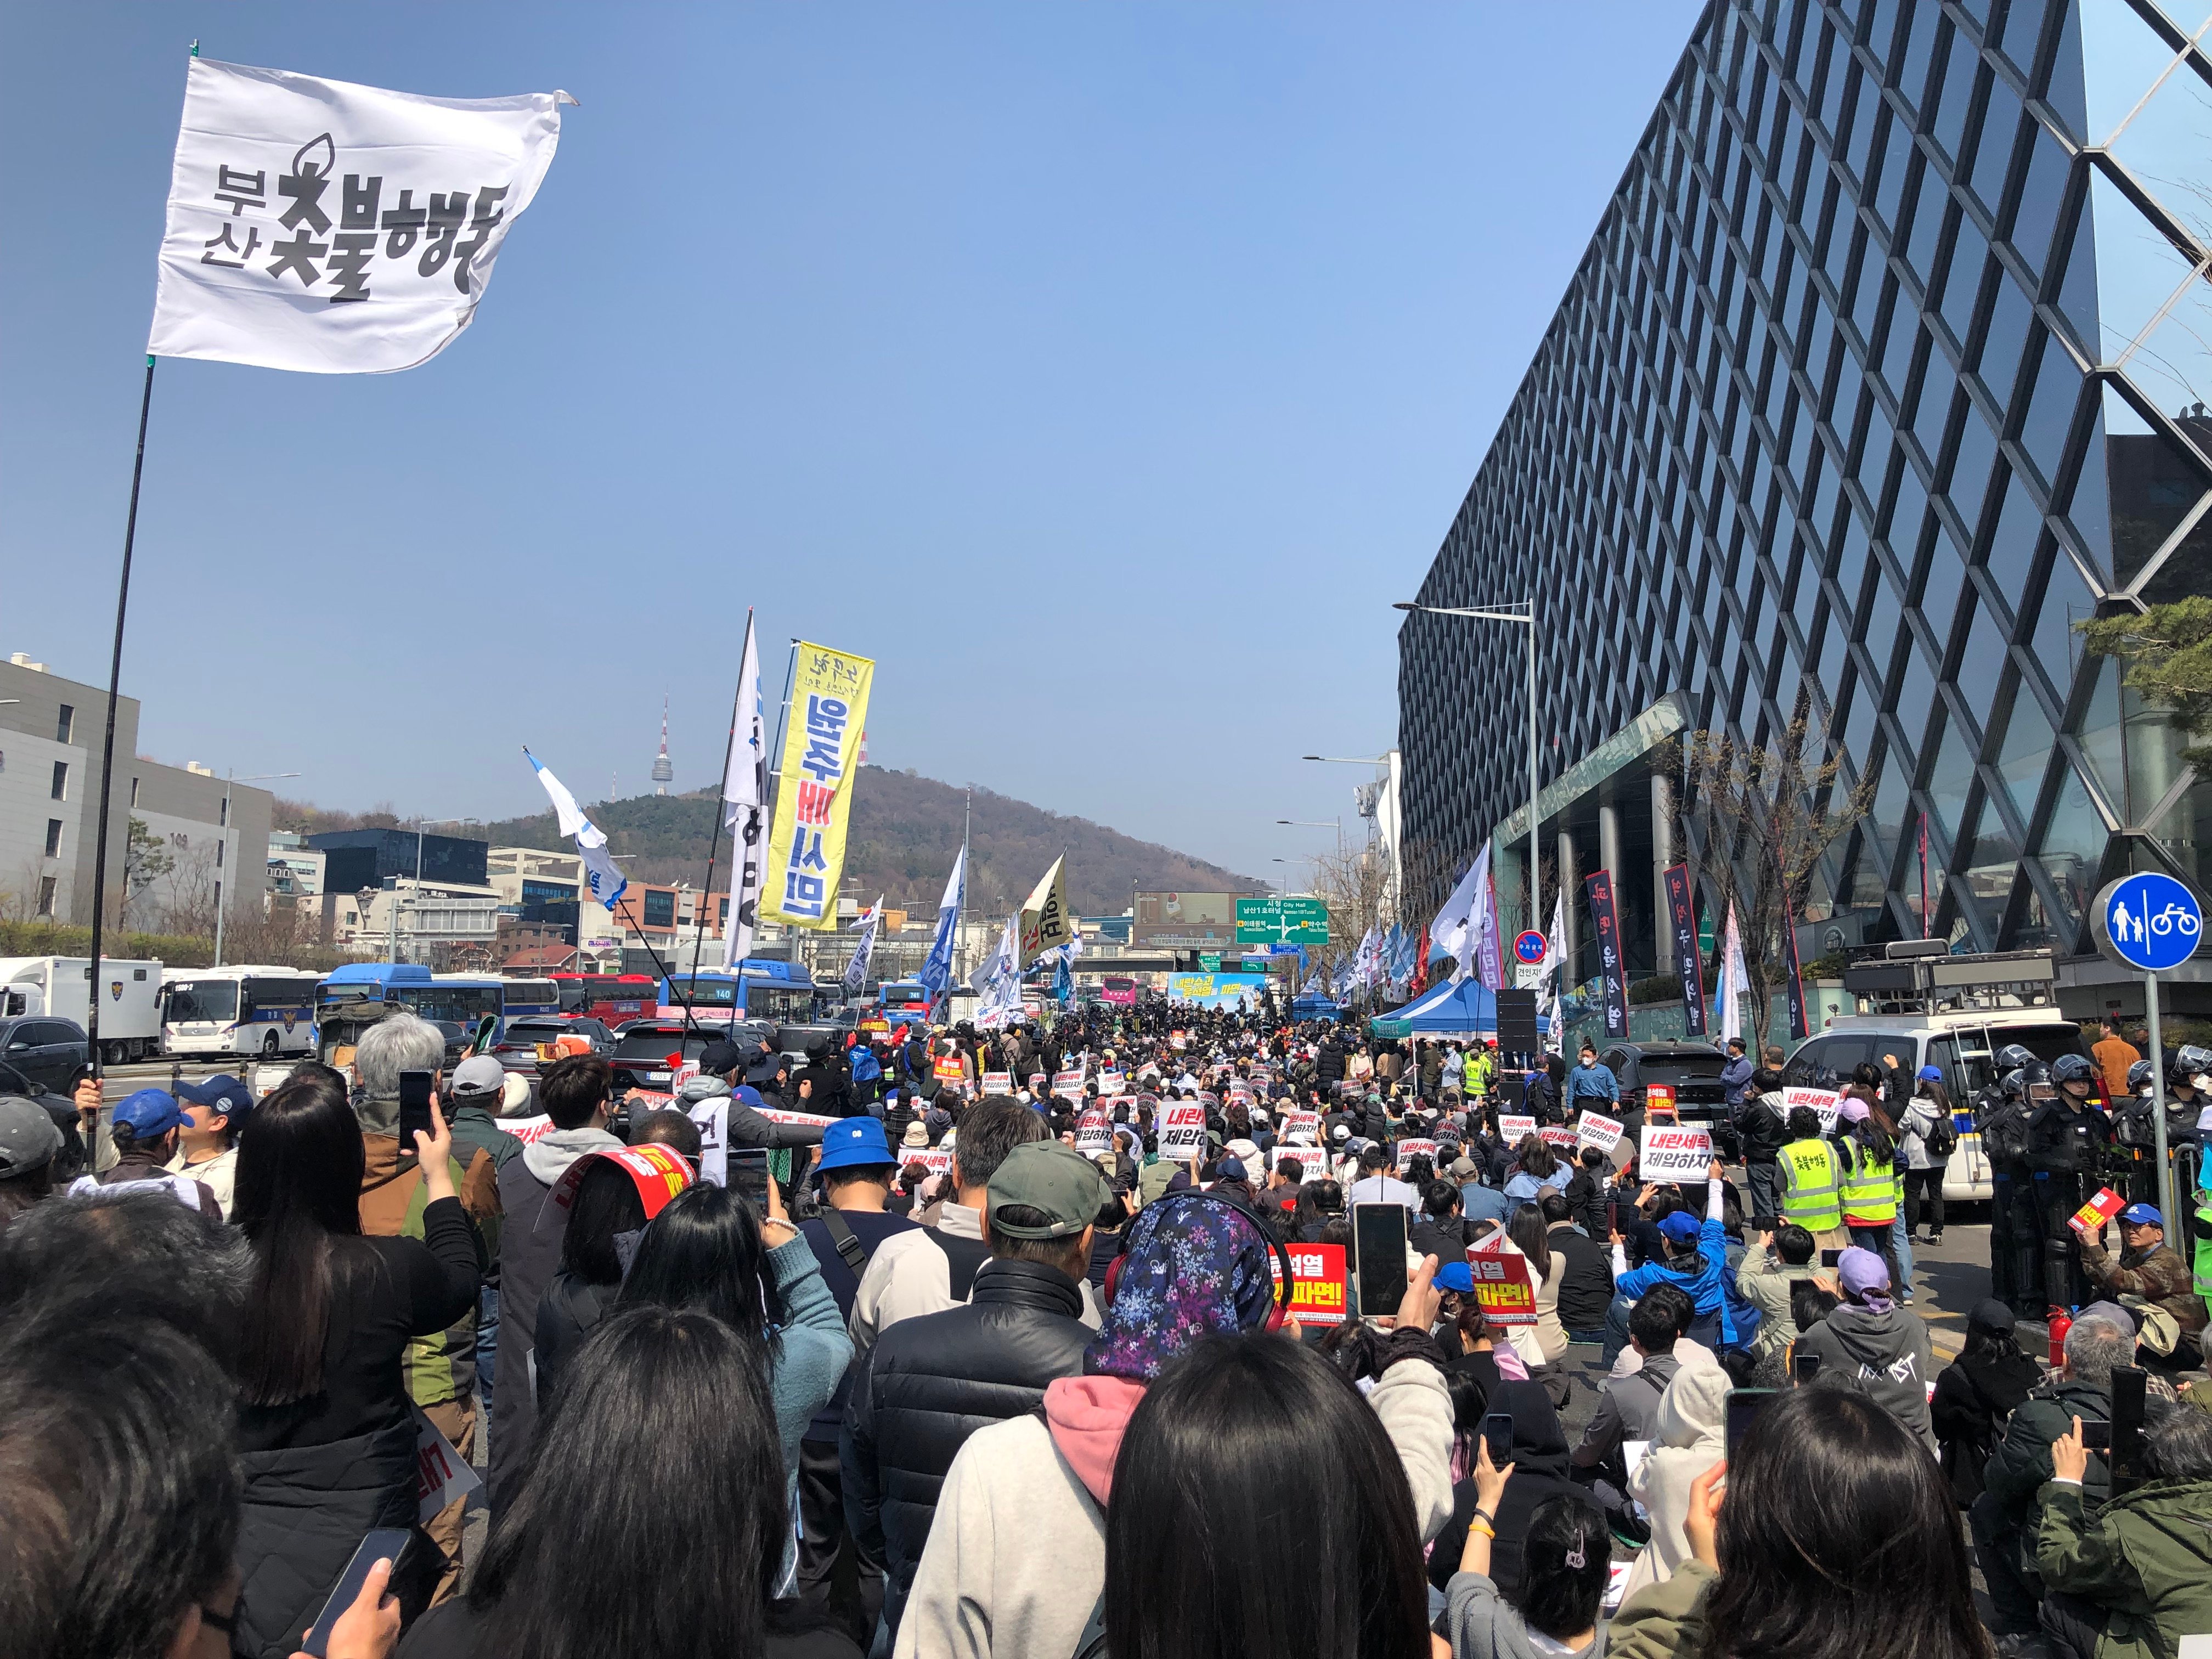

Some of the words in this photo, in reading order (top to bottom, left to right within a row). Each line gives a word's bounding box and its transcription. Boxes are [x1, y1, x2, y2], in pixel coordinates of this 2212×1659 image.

[266, 159, 513, 303] 촛불행동
[1174, 975, 1215, 990] 내란수괴
[716, 990, 730, 998] 140
[1054, 1080, 1082, 1088] 제압하자!
[1055, 1073, 1081, 1081] 내란세력
[1787, 1092, 1836, 1108] 내란세력
[1502, 1119, 1533, 1128] 내란세력
[1584, 1116, 1621, 1135] 내란세력
[1539, 1131, 1578, 1145] 내란세력
[1578, 1125, 1618, 1145] 제압하자!
[1648, 1133, 1709, 1150] 내란세력
[1400, 1142, 1436, 1153] 내란세력
[902, 1154, 948, 1168] 내란세력
[1795, 1153, 1826, 1171] 촛불행동
[1291, 1281, 1341, 1306] 파면!
[1474, 1283, 1531, 1306] 파면!
